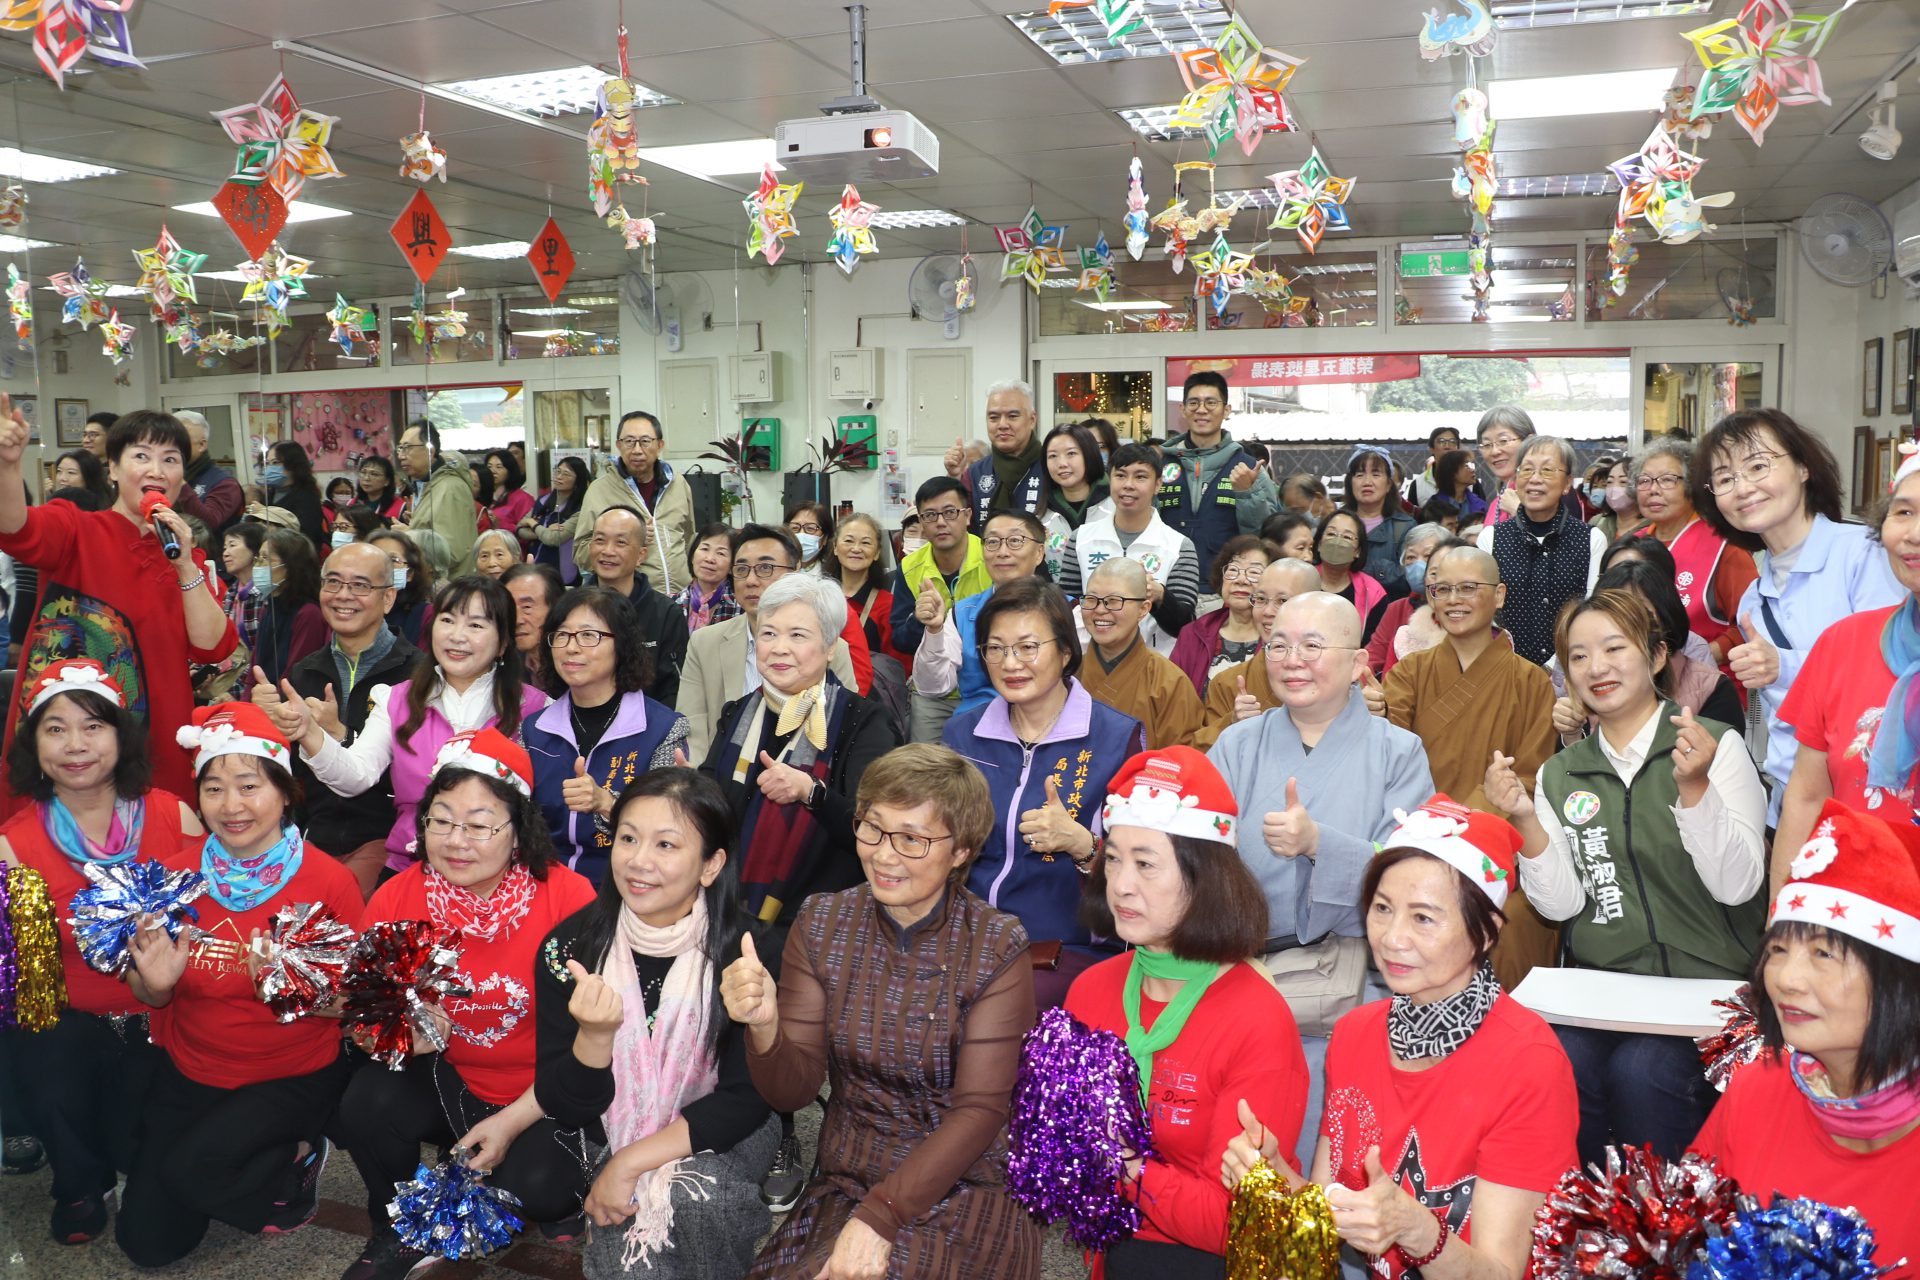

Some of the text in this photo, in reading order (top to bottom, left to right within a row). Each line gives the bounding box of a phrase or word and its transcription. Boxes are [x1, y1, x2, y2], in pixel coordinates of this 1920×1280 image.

[406, 209, 437, 258] 興
[542, 237, 560, 276] 里
[1053, 757, 1068, 788] 局長
[1581, 826, 1624, 920] 黃淑君
[449, 999, 509, 1016] Impossible
